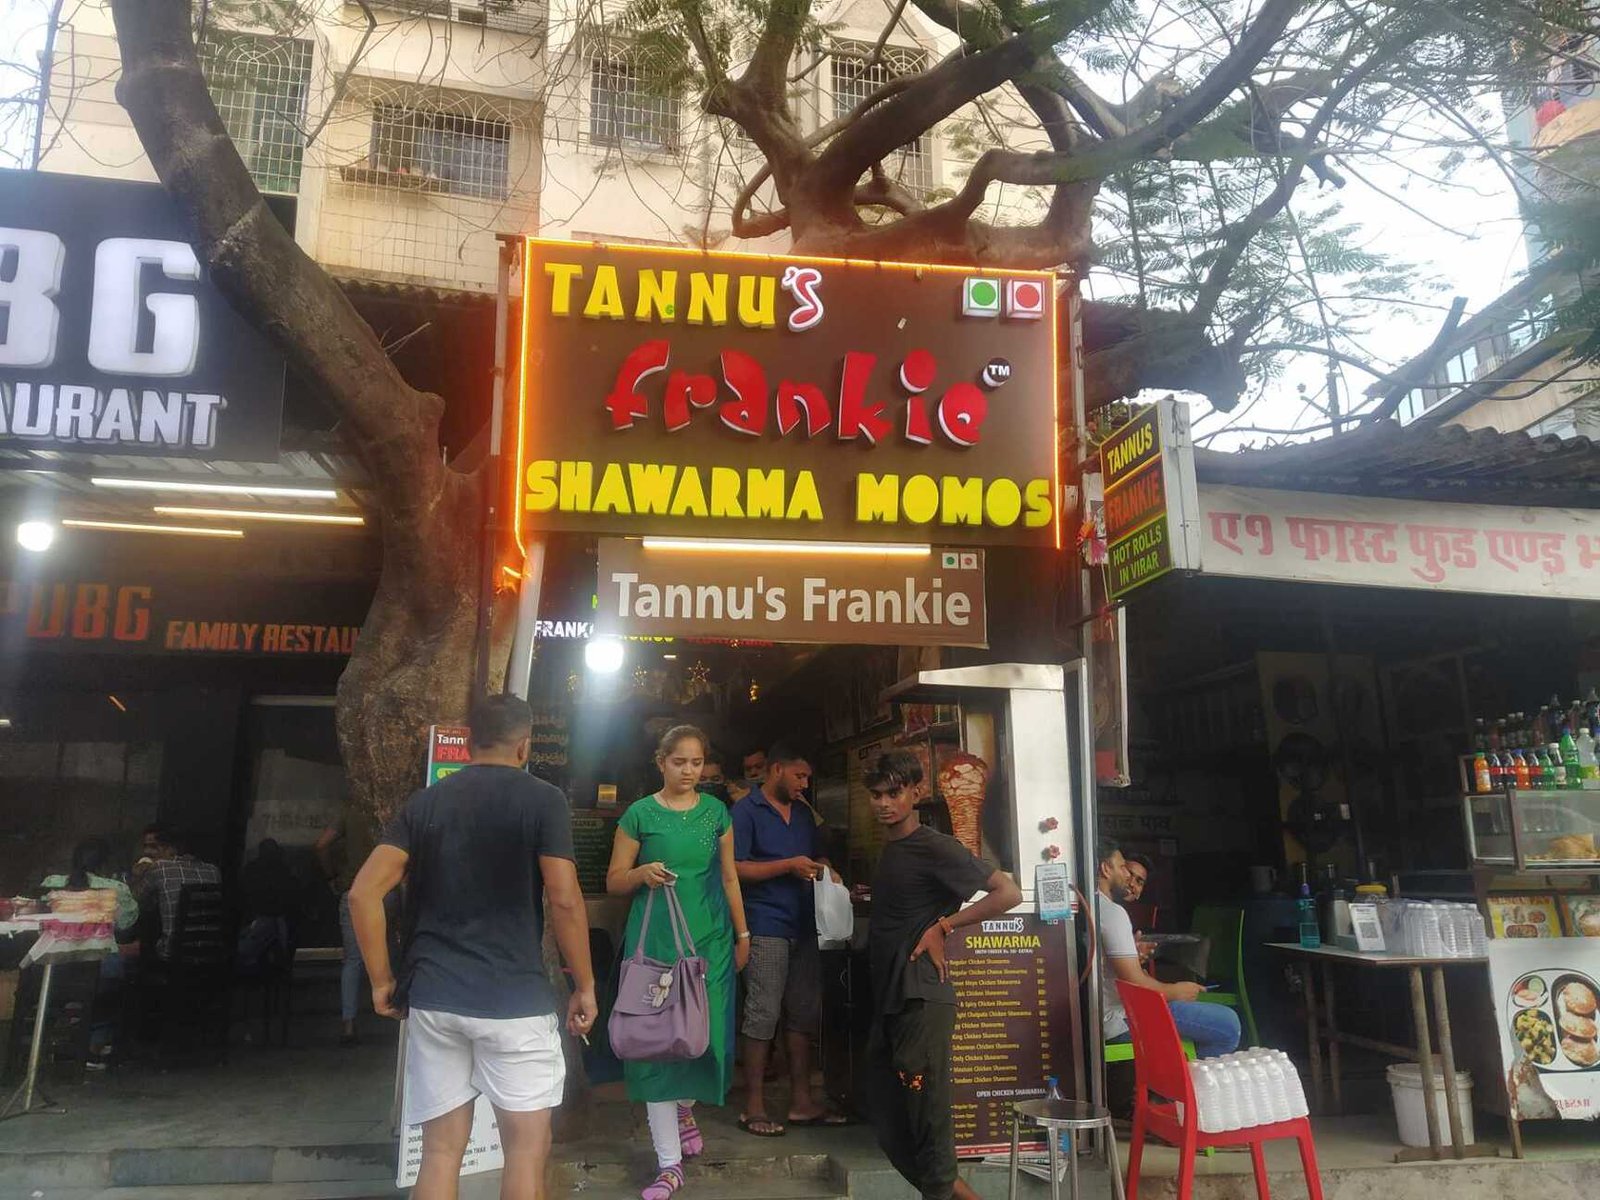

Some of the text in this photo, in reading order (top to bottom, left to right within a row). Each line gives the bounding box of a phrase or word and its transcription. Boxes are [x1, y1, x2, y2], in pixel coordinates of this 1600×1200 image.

[988, 364, 1010, 377] TM
[0, 382, 224, 448] URANT
[1107, 422, 1153, 476] TANNUS
[525, 460, 1053, 529] SHAWARMA MOMOS
[1107, 469, 1160, 532] FRANKIE
[1112, 525, 1162, 567] HOT ROLLS
[1285, 516, 1398, 563] फास्ट
[1119, 552, 1160, 587] IN VIRAR
[611, 572, 972, 626] Tannu's Frankie
[165, 620, 259, 650] FAMILY
[965, 935, 1042, 949] SHAWARMA
